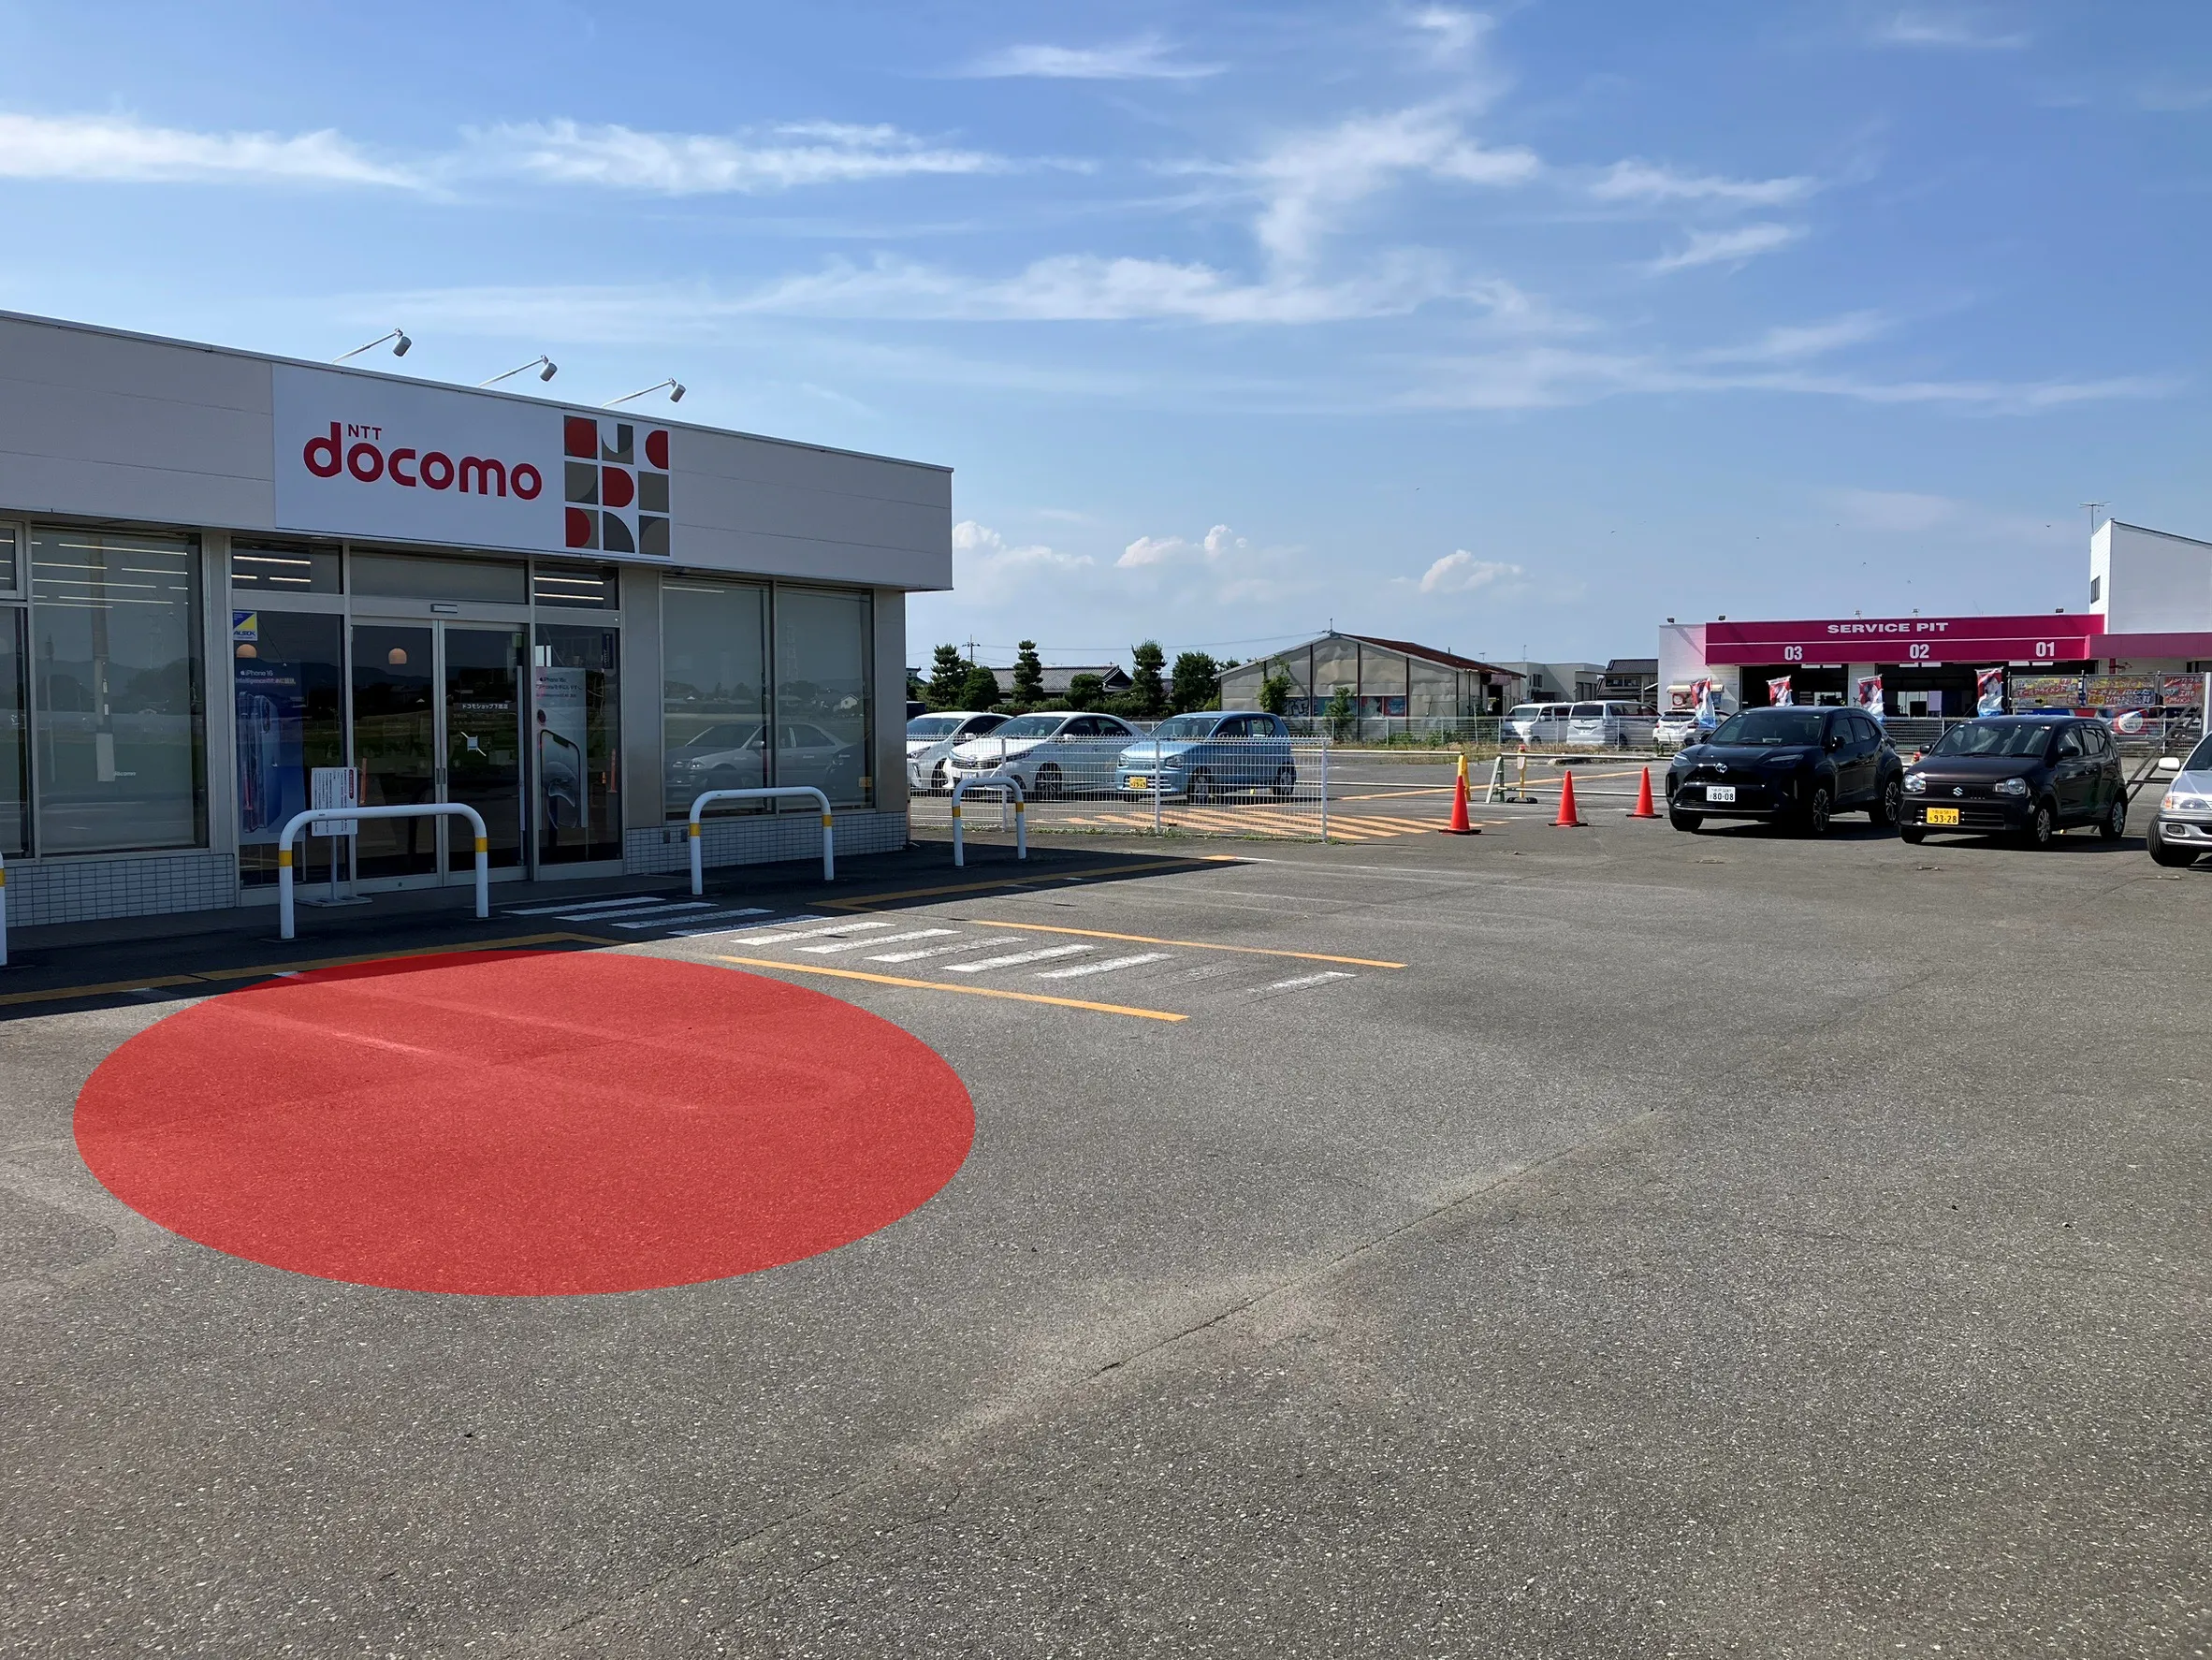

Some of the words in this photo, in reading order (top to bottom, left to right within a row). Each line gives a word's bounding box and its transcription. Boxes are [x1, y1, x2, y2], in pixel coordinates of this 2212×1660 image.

[347, 423, 382, 441] NTT
[303, 421, 543, 501] docomo
[1826, 622, 1911, 633] SERVICE
[1916, 622, 1949, 632] PIT
[1783, 646, 1803, 661] 03
[1909, 644, 1929, 659] 02
[2035, 642, 2055, 657] 01
